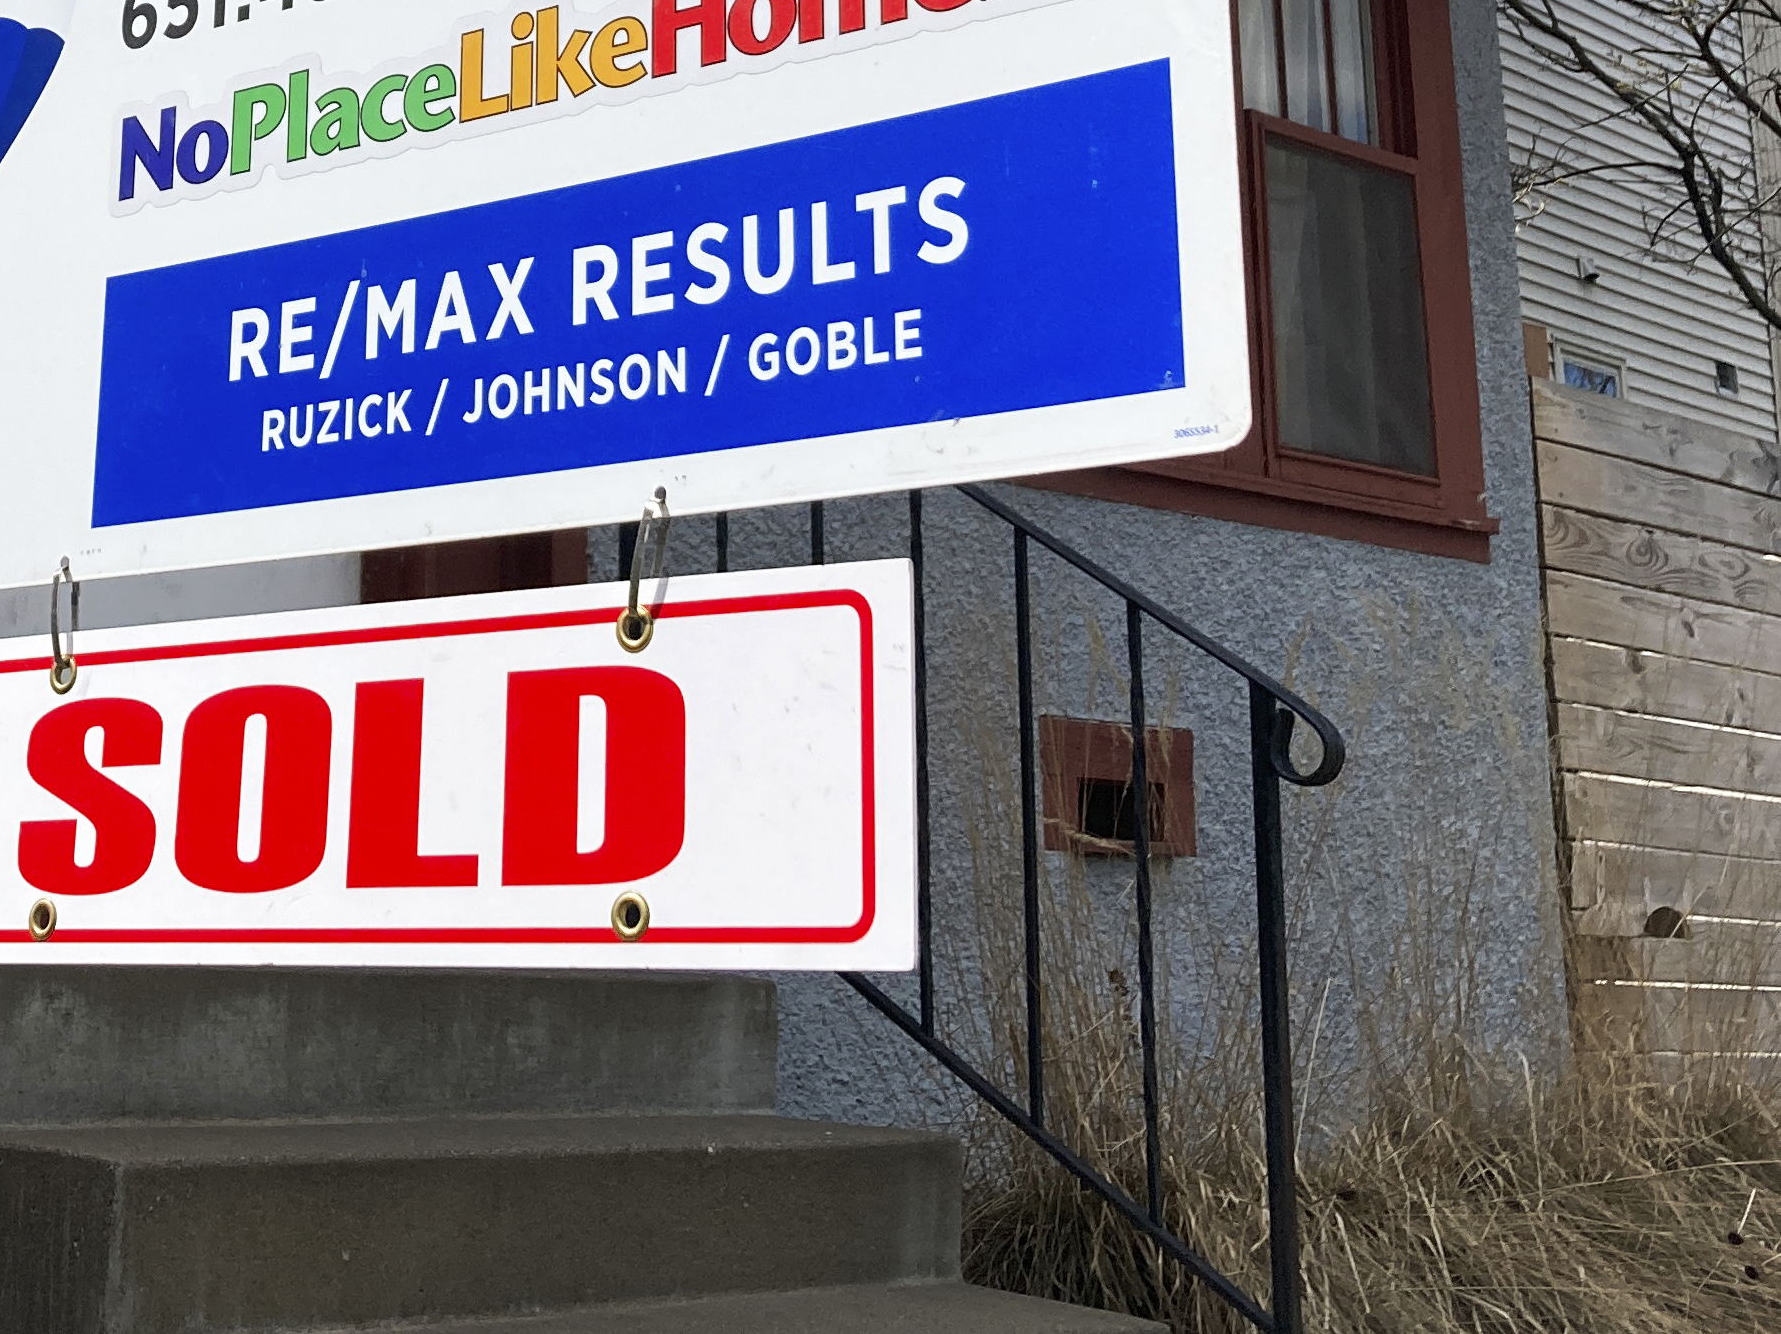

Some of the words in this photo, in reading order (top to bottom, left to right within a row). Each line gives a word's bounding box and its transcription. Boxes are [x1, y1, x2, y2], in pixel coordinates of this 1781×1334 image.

[228, 257, 535, 382] RE/MAX
[572, 176, 970, 325] RESULTS
[261, 388, 412, 452] RUZICK
[462, 347, 688, 423] JOHNSON
[748, 309, 924, 380] GOBLE
[17, 665, 687, 896] SOLD
